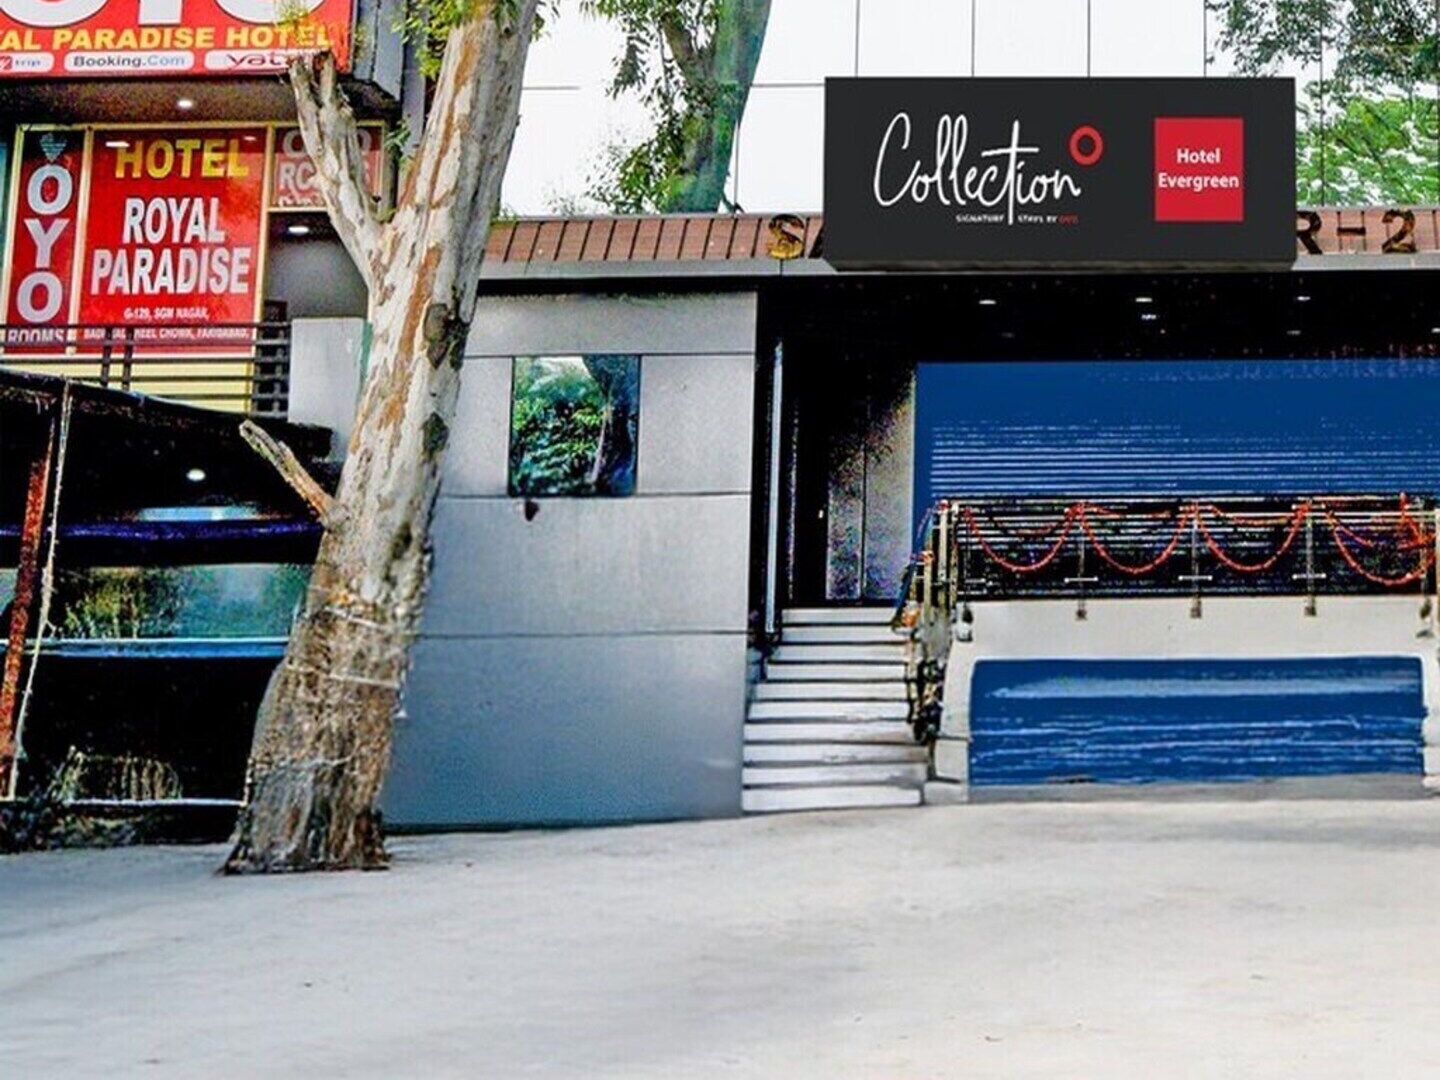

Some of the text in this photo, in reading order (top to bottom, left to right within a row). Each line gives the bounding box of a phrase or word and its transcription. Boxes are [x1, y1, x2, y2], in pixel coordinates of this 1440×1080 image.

[0, 25, 332, 51] AL PARADISE HOTEL
[73, 54, 186, 69] Booking.Com
[226, 51, 286, 69] yat
[114, 138, 249, 180] HOTEL
[873, 112, 1082, 225] Collection
[1176, 147, 1221, 164] Hotel
[1158, 172, 1240, 193] Evergreen
[122, 196, 226, 245] ROYAL
[16, 163, 73, 324] OYO
[90, 247, 252, 297] PARADISE
[8, 328, 67, 343] ROOMS
